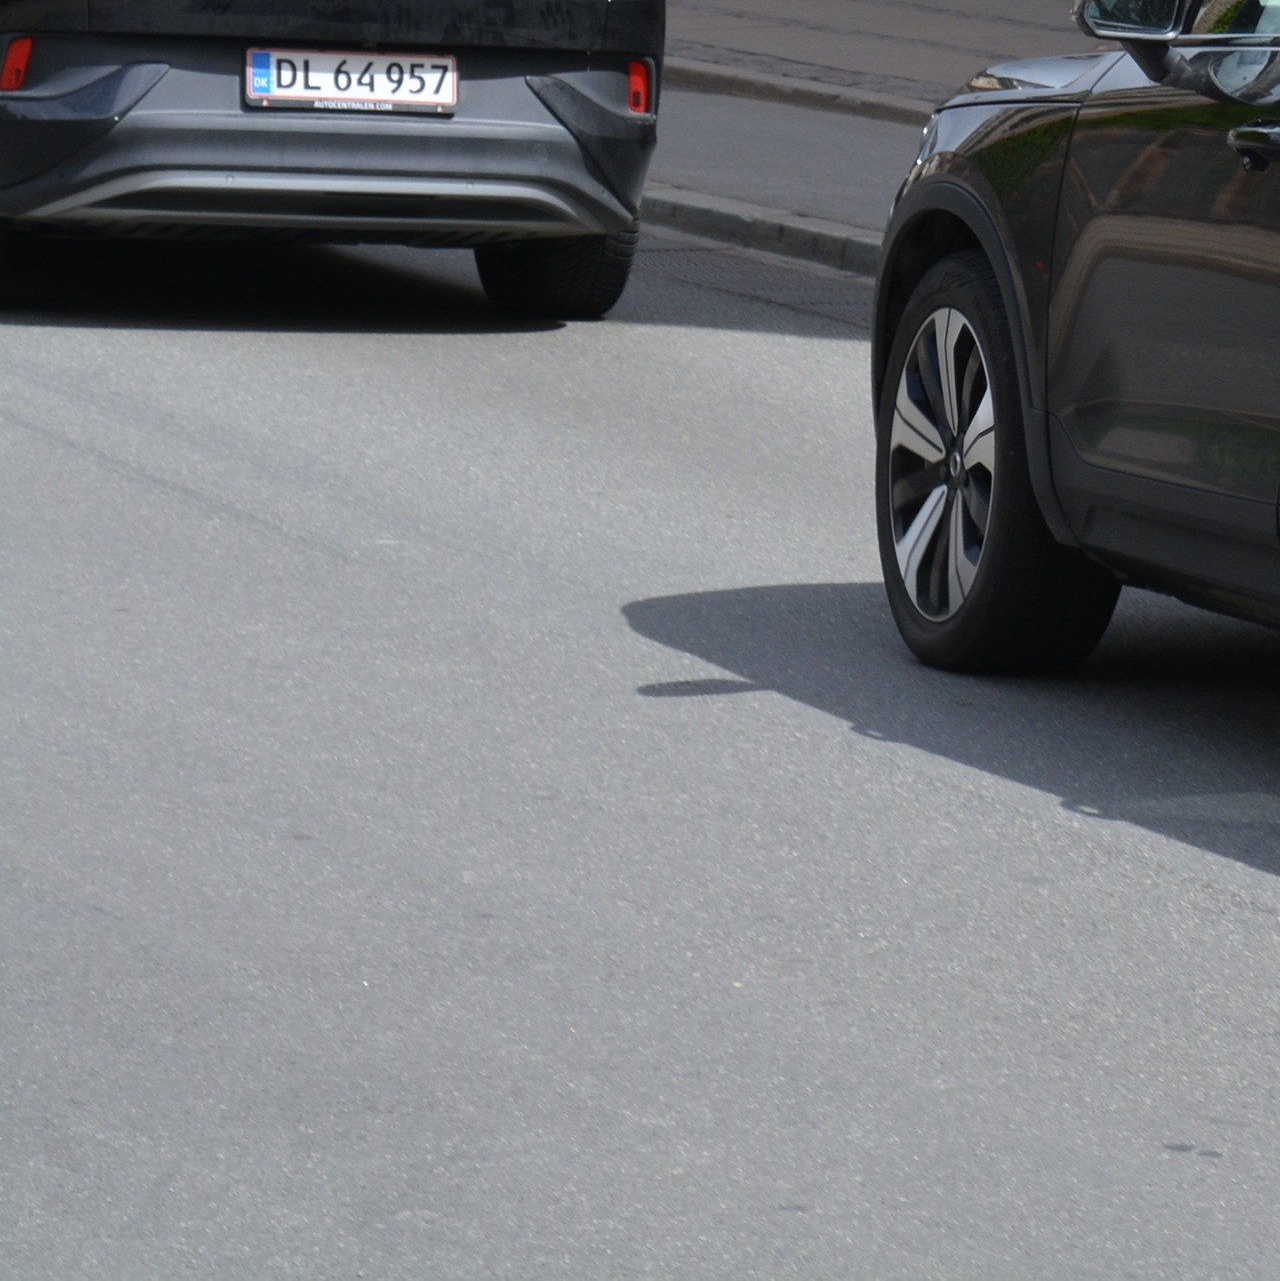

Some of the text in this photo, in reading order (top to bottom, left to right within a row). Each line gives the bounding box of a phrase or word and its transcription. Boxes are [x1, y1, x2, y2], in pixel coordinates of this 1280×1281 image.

[276, 58, 321, 91] DL
[253, 77, 268, 88] DK
[314, 99, 393, 111] AUTOCENTRALEN.COM
